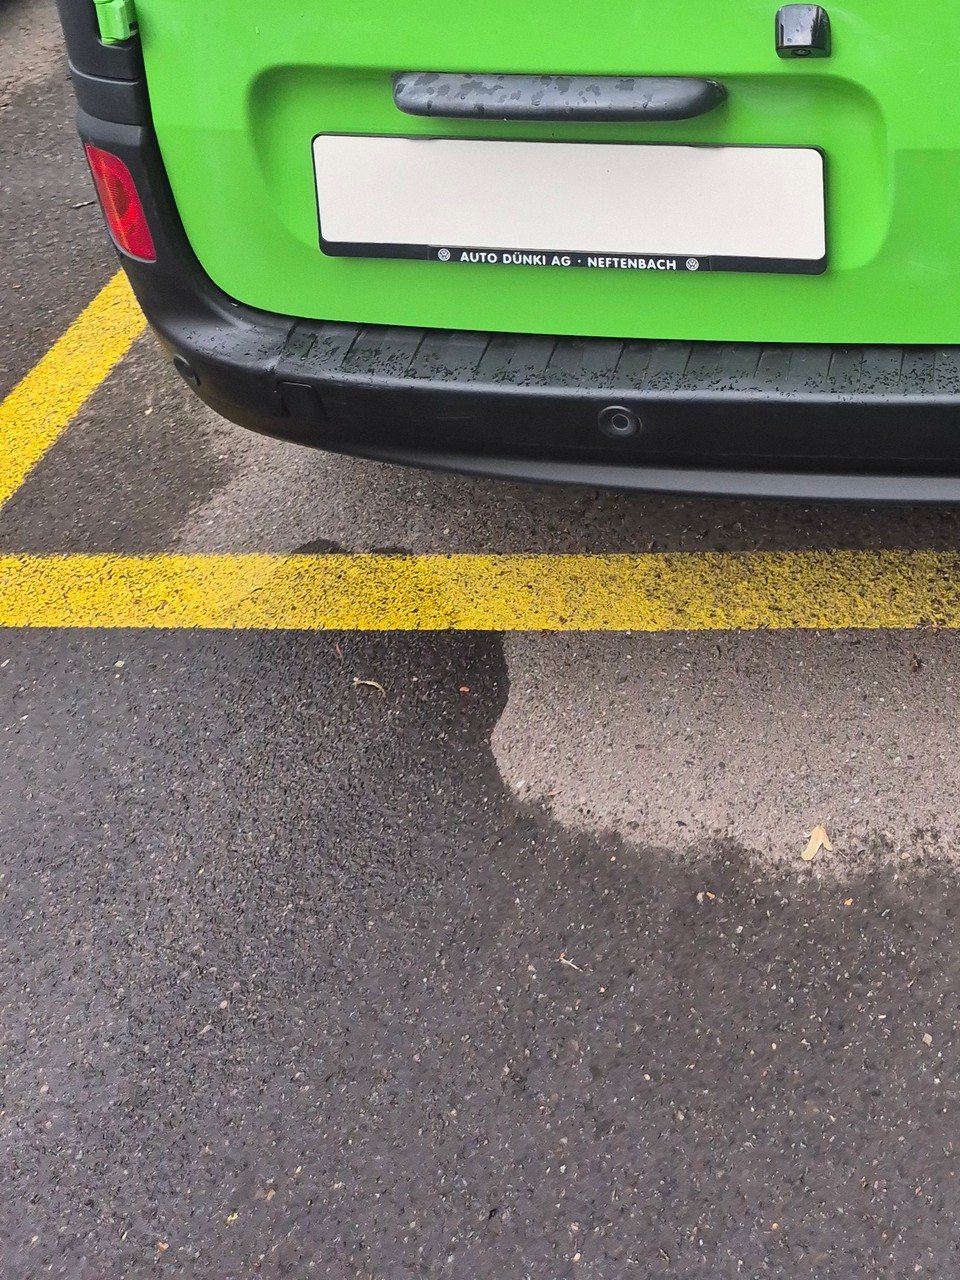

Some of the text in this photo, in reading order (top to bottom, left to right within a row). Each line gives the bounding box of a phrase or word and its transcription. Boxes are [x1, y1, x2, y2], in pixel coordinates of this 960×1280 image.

[460, 251, 498, 263] AUTO
[502, 252, 546, 266] DÜNKI
[551, 256, 571, 266] AG
[587, 256, 677, 270] NEFTENBACH
